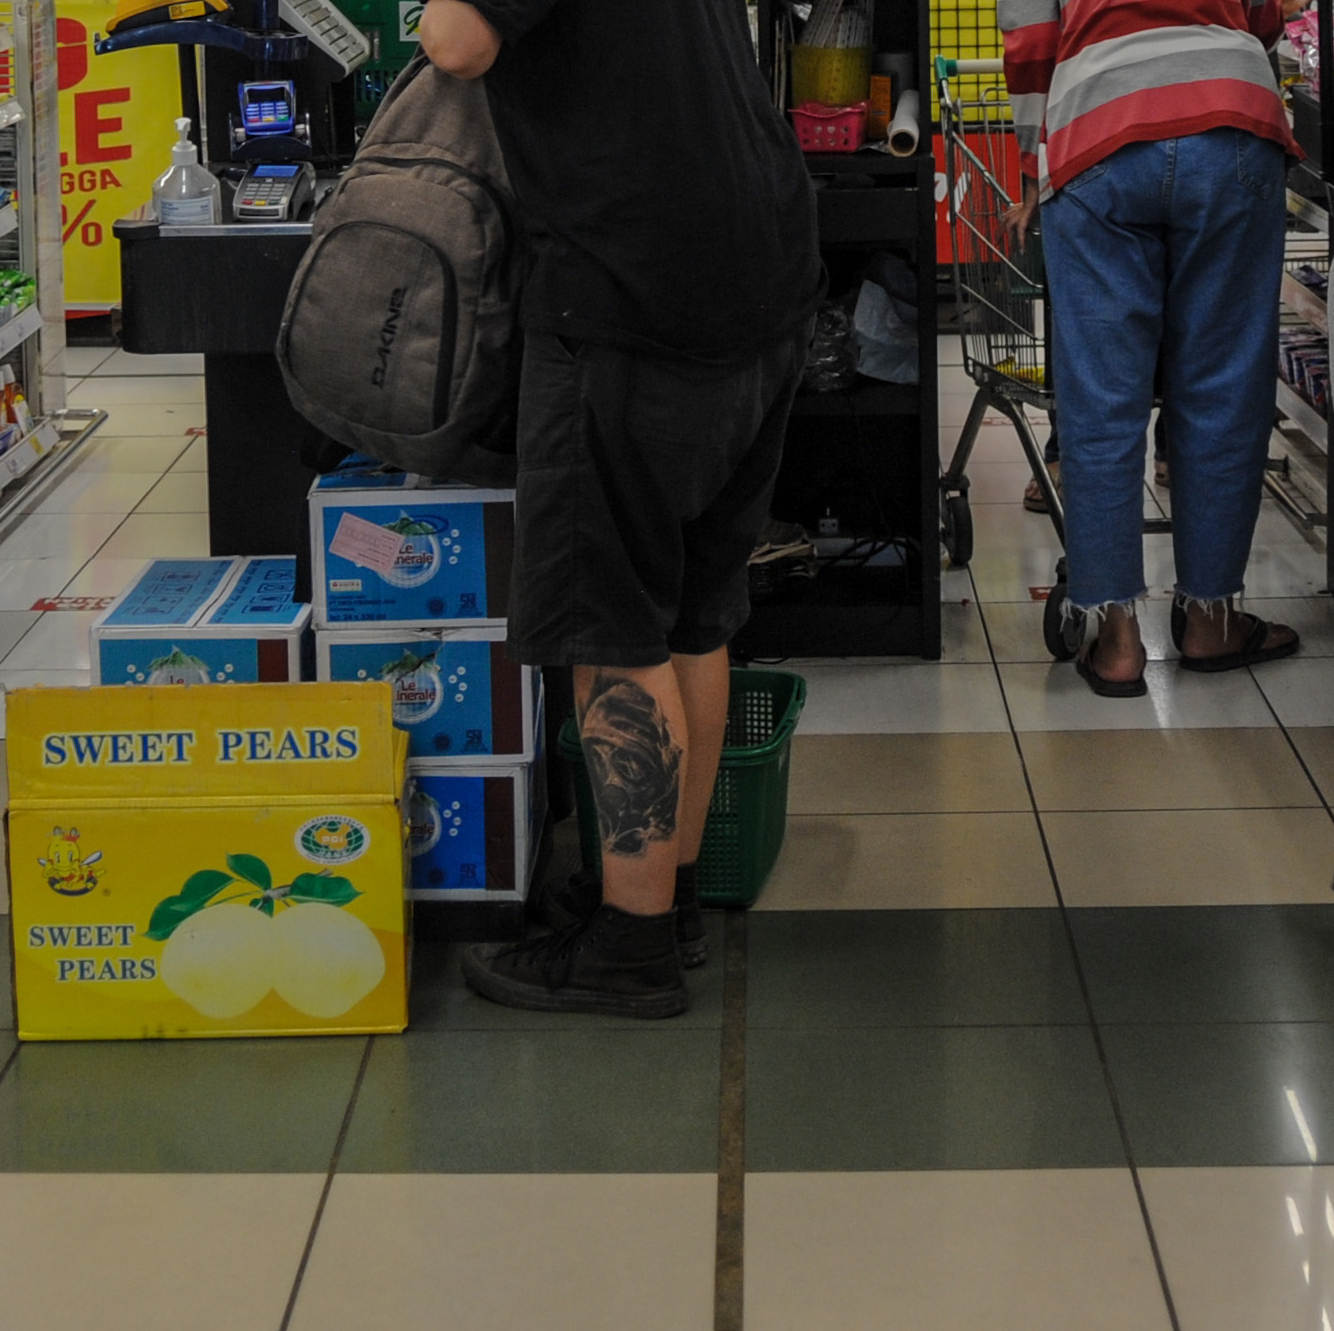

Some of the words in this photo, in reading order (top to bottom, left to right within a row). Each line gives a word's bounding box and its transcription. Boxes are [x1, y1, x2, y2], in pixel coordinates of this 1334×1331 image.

[371, 287, 408, 390] DAKINE
[402, 682, 415, 691] Le
[43, 732, 194, 766] SWEET
[218, 729, 359, 761] PEARS
[28, 925, 135, 948] SWEET
[57, 958, 157, 982] PEARS
